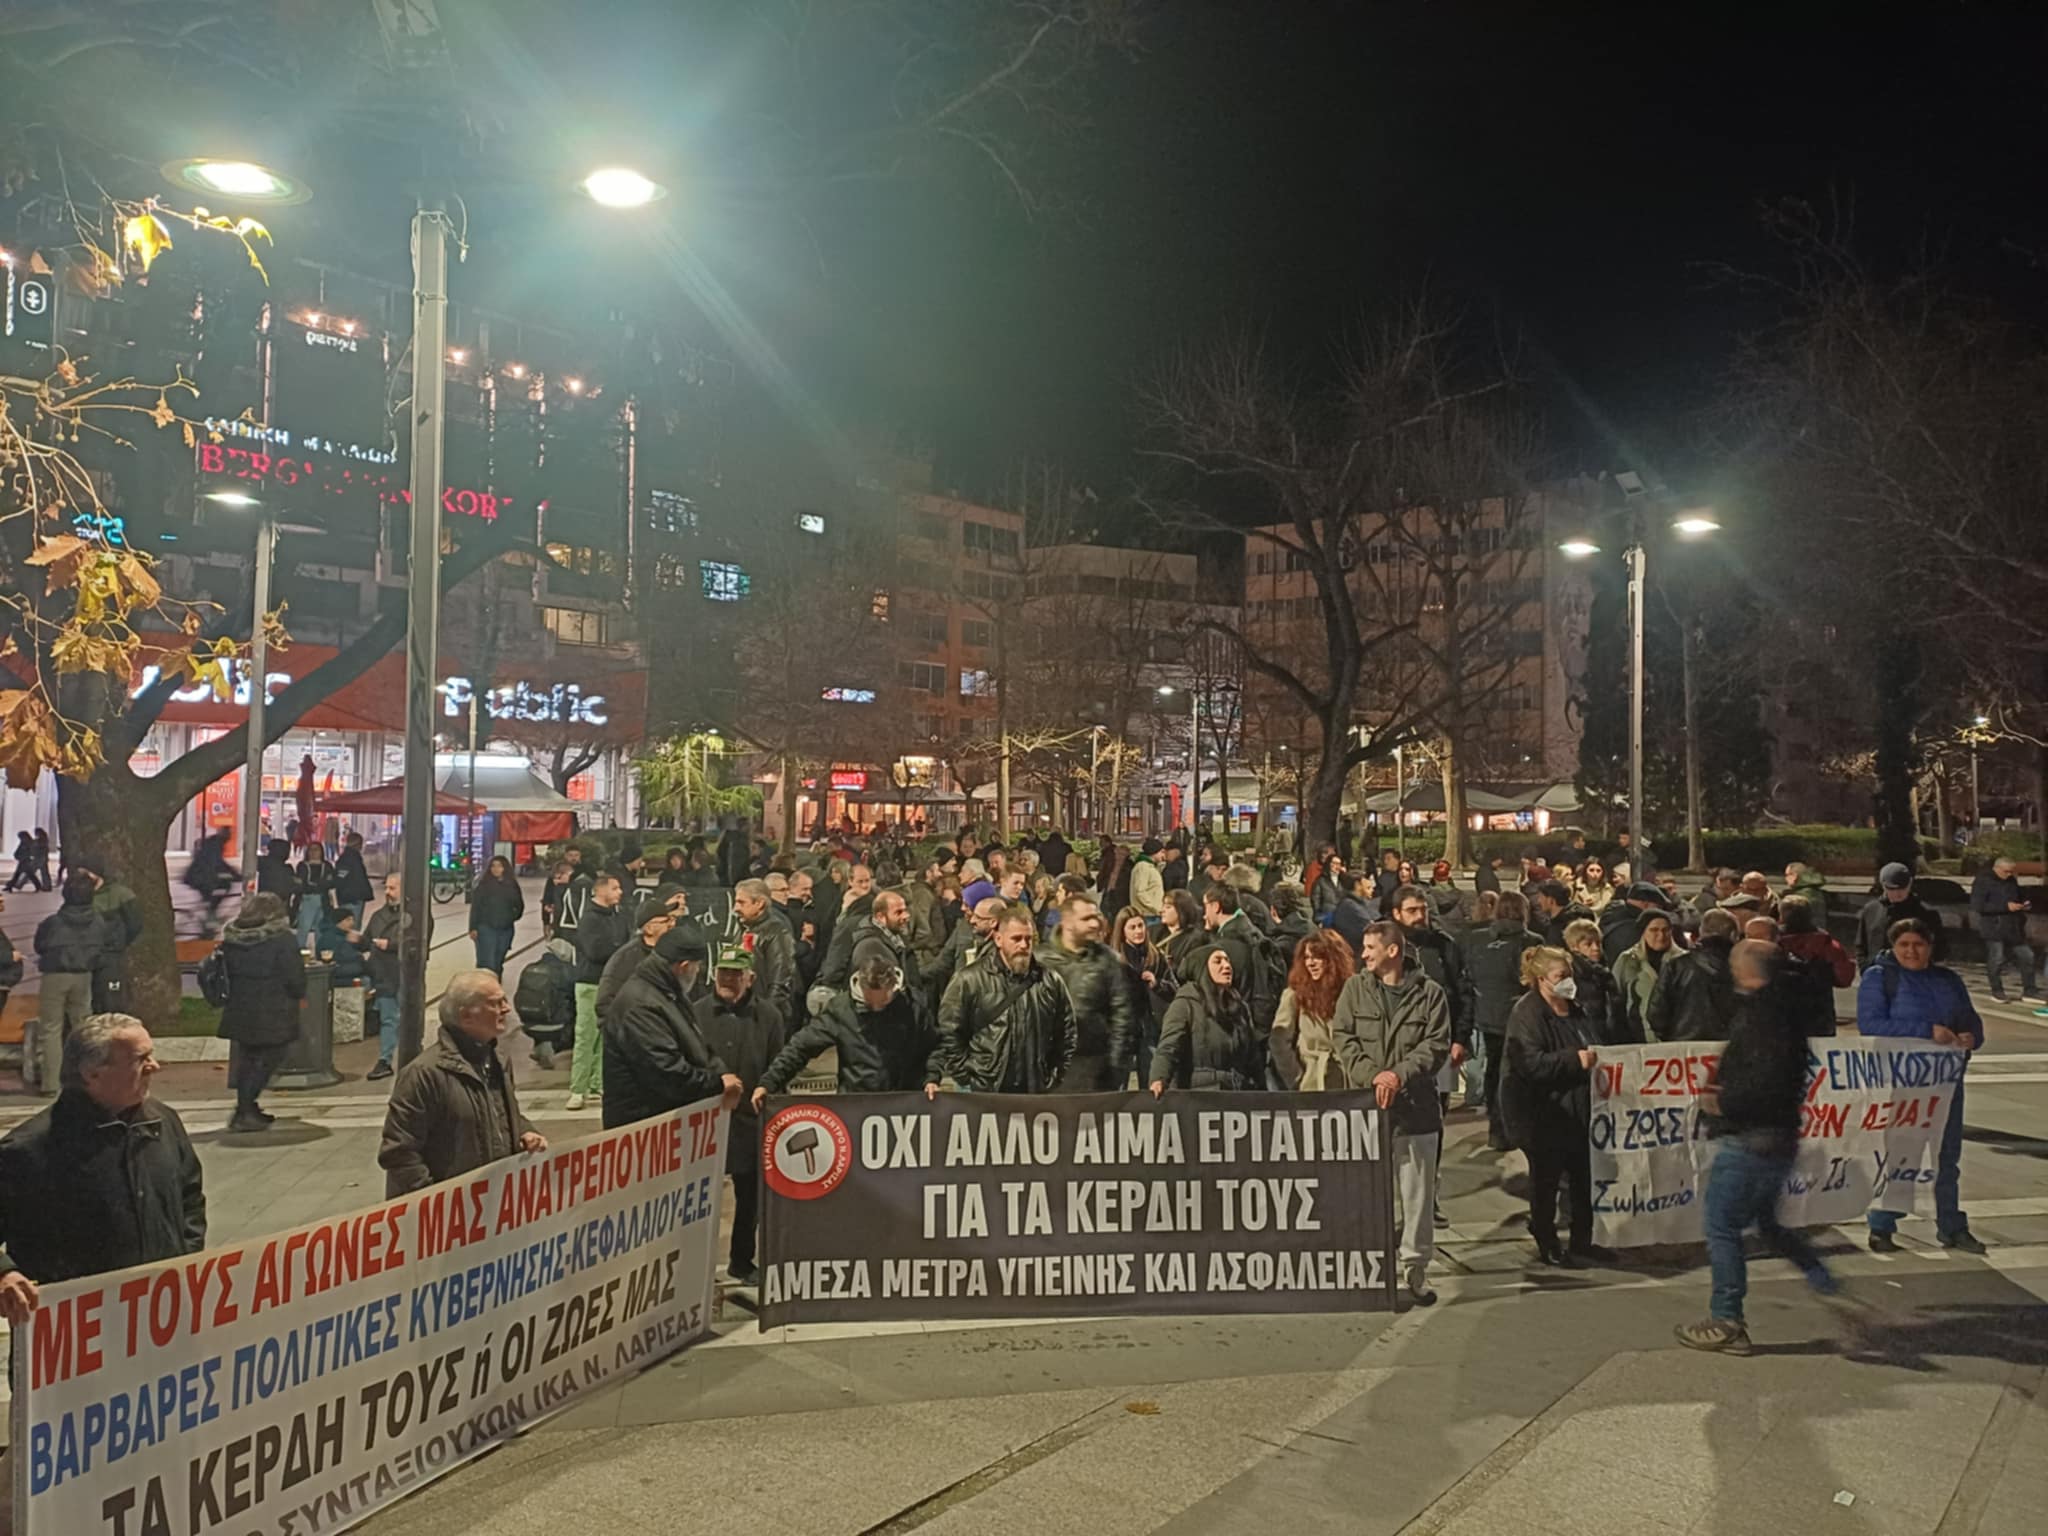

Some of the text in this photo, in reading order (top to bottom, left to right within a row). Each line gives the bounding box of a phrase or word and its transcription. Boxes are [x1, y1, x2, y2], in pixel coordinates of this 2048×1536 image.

[441, 486, 514, 519] KOR
[444, 676, 608, 725] Public
[1595, 1062, 1624, 1099] ΟΙ
[1827, 1050, 1885, 1090] ΕΙΝΑΙ
[1888, 1051, 1966, 1088] ΚΟΣΤΟΣ
[861, 1109, 1381, 1169] ΟΧΙ ΑΛΛΟ ΑΙΜΑ ΕΡΓΑΤΩΝ
[1590, 1111, 1617, 1150] ΟΙ
[1624, 1107, 1685, 1150] ΖΩΕΣ
[1795, 1103, 1852, 1139] ΟΥΝ
[1860, 1095, 1941, 1130] ΑΞΙΑ!
[923, 1178, 1321, 1239] ΓΙΑ ΤΑ ΚΕΡΔΗ ΤΟΥΣ
[32, 1106, 721, 1392] ΜΕ ΤΟΥΣ ΑΓΩΝΕΣ ΜΑΣ ΑΝΑΤΡΕΠΟΥΜΕ ΤΙΣ
[763, 1251, 1387, 1306] ΑΜΕΣΑ ΜΕΤΡΑ ΥΓΙΕΙΝΗΣ ΚΑΙ ΑΣΦΑΛΕΙΑΣ
[30, 1356, 222, 1497] ΒΑΡΒΑΡΕΣ
[232, 1292, 401, 1411] ΠΟΛΙΤΙΚΕΣ
[102, 1249, 681, 1536] ΤΑ ΚΕΡΔΗ ΤΟΥΣ ή ΟΙ ΖΩΕΣ ΜΑΣ
[278, 1303, 702, 1536] ΣΥΝΤΑΞΙΟΥΧΩΝ ΙΚΑ Ν. ΛΑΡΙΣΑΣ
